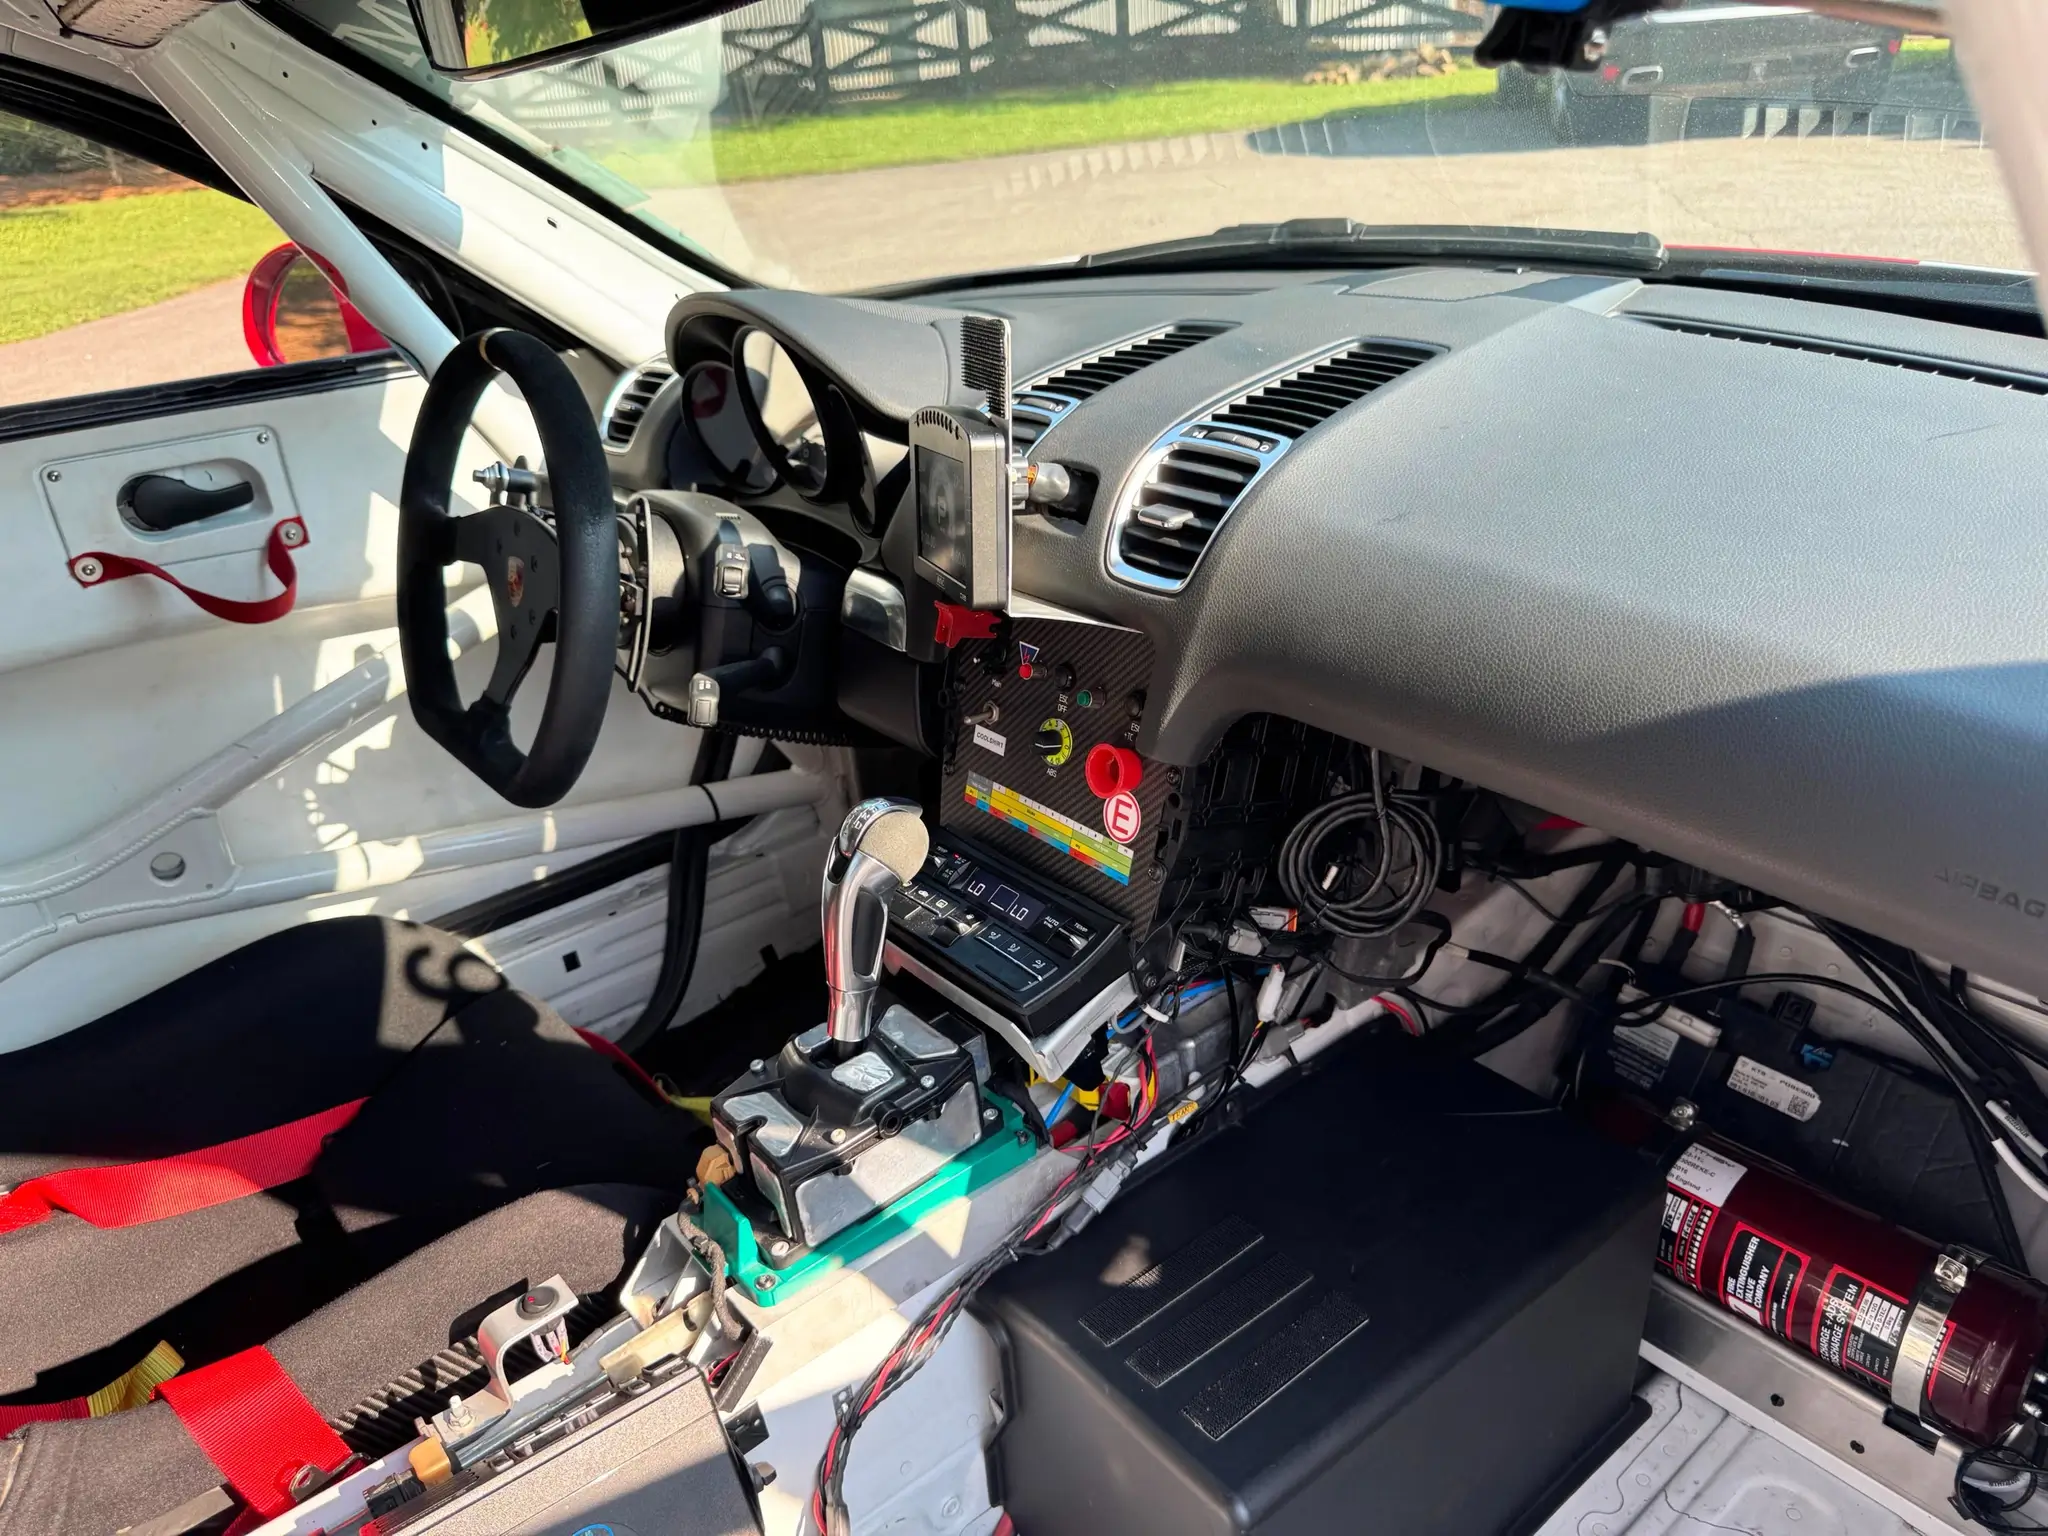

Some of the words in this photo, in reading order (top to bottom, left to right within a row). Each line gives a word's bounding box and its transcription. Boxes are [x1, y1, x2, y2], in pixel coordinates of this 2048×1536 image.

[1057, 703, 1068, 713] OFF
[1046, 768, 1057, 778] ABS
[1112, 797, 1133, 836] E
[1932, 866, 2046, 918] AIRBAG
[1045, 915, 1059, 927] AUTO
[1074, 921, 1088, 933] TEMP
[1675, 1175, 1701, 1191] England
[1735, 1236, 1761, 1300] EXTINGUISHER
[1726, 1276, 1736, 1295] FIRE
[1744, 1277, 1756, 1304] VALVE
[1754, 1265, 1770, 1309] COMPANY
[1836, 1283, 1859, 1324] SYSTEM
[1820, 1326, 1830, 1355] CHARGE
